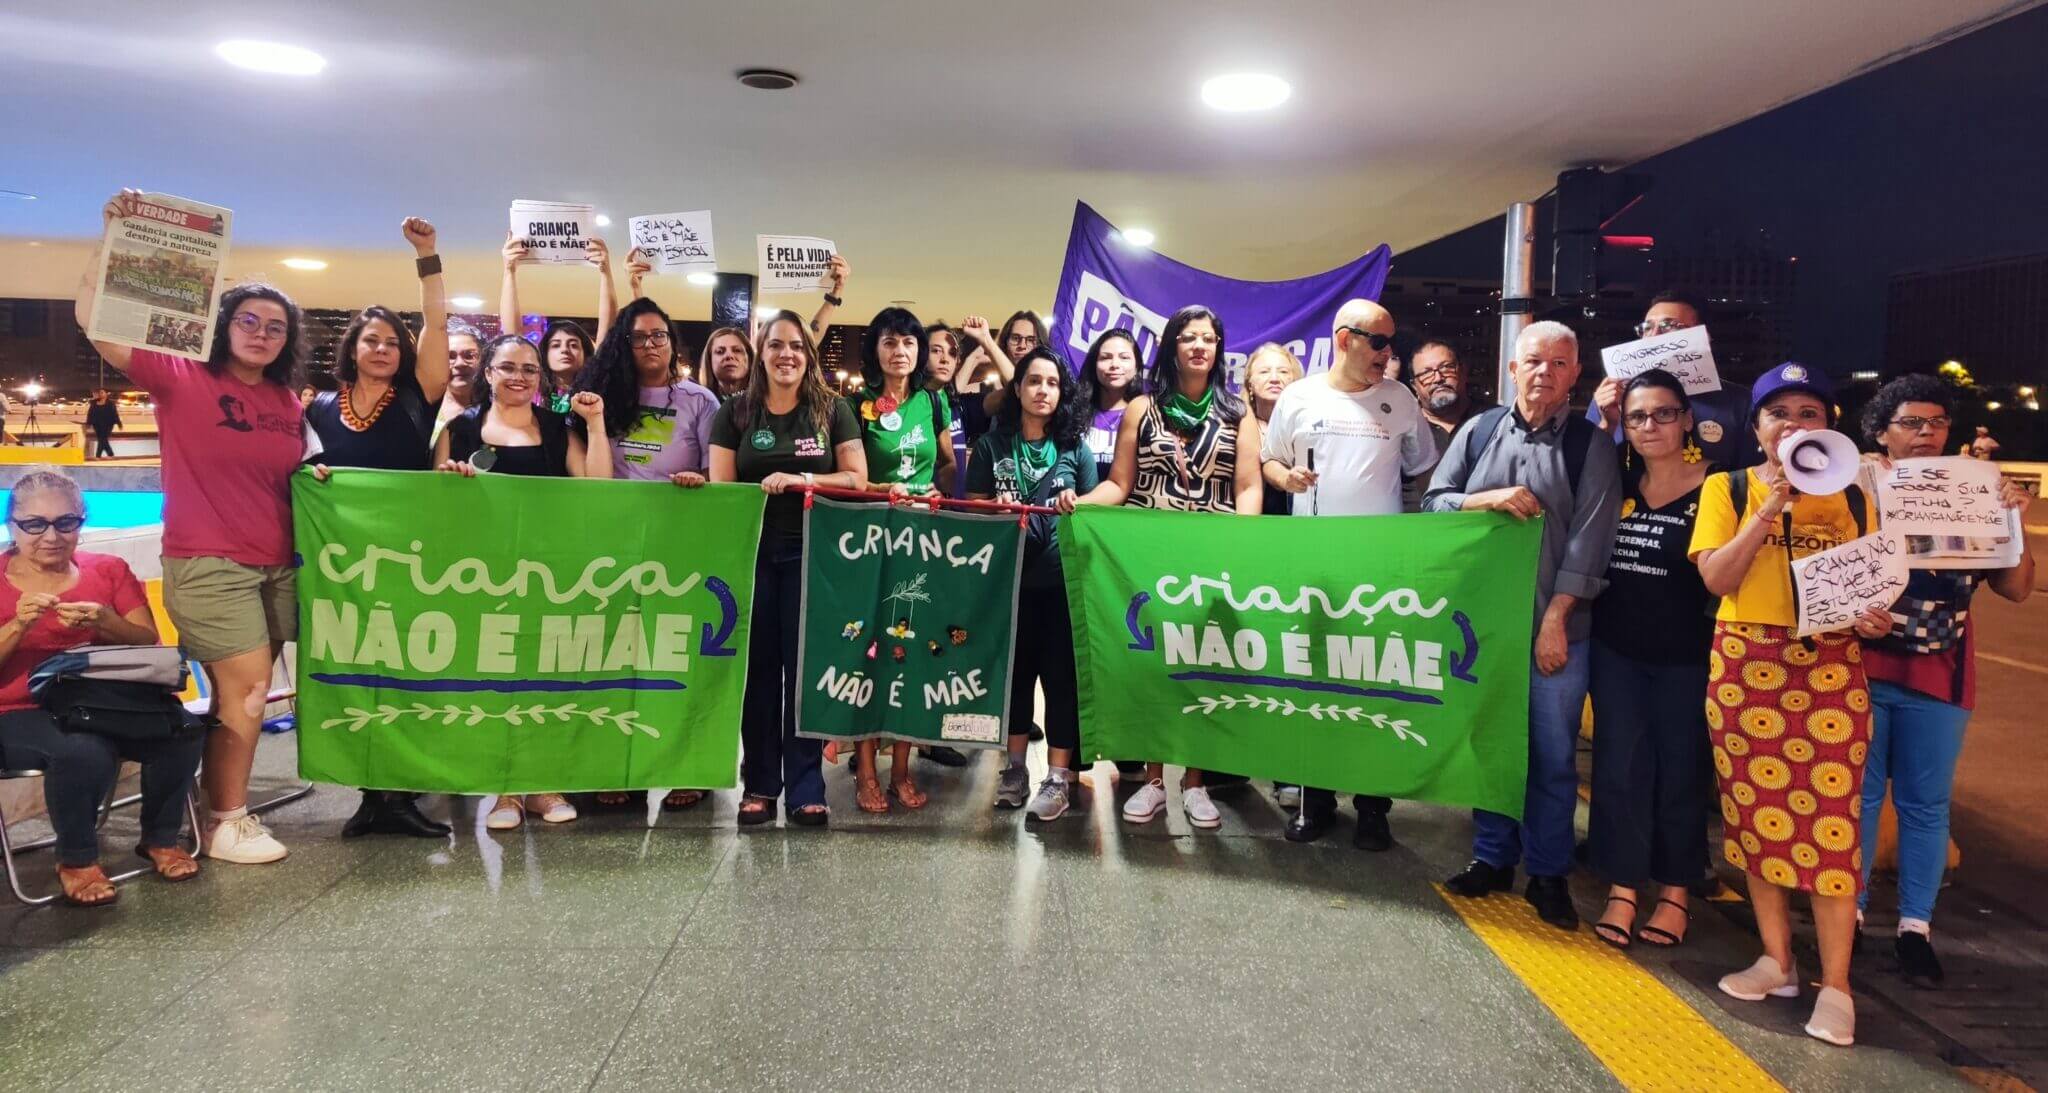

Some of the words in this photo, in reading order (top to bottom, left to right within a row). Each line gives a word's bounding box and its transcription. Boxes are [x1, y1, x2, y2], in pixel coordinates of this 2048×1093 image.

[136, 203, 189, 226] VERDADE
[123, 220, 168, 237] Ganância
[170, 233, 217, 249] capitalista
[529, 222, 579, 240] CRIANÇA
[636, 219, 683, 231] CRIANÇA
[125, 230, 161, 244] destrói
[170, 242, 212, 257] natureza
[521, 238, 547, 249] NÃO
[550, 238, 557, 249] É
[640, 247, 662, 258] NEM
[664, 245, 708, 260] ESPOSA
[767, 244, 774, 262] É
[777, 247, 804, 262] PELA
[806, 248, 832, 262] VIDA
[768, 262, 785, 270] DAS
[787, 262, 832, 270] MULHERES
[1611, 340, 1688, 364] CONGRESSO
[1674, 352, 1703, 362] DAS
[1896, 468, 1913, 480] E
[1921, 468, 1949, 480] SE
[1888, 481, 1949, 493] FOSSE
[1957, 482, 1989, 494] SUA
[1896, 496, 1952, 508] FILHA
[1650, 526, 1664, 535] AS
[838, 524, 994, 575] CRIANÇA
[1866, 534, 1896, 560] NÃO
[319, 540, 701, 612] criança
[1155, 571, 1449, 626] criança
[1806, 575, 1903, 616] ESTUPRADOR
[1808, 611, 1849, 628] NÃO
[310, 598, 457, 672] NÃO
[476, 601, 520, 673] É
[537, 605, 693, 673] MÃE
[1162, 619, 1268, 671] NÃO
[1281, 625, 1313, 677] É
[1326, 631, 1445, 691] MÃE
[816, 665, 874, 709] NÃO
[888, 673, 905, 708] É
[922, 668, 988, 710] MÃE
